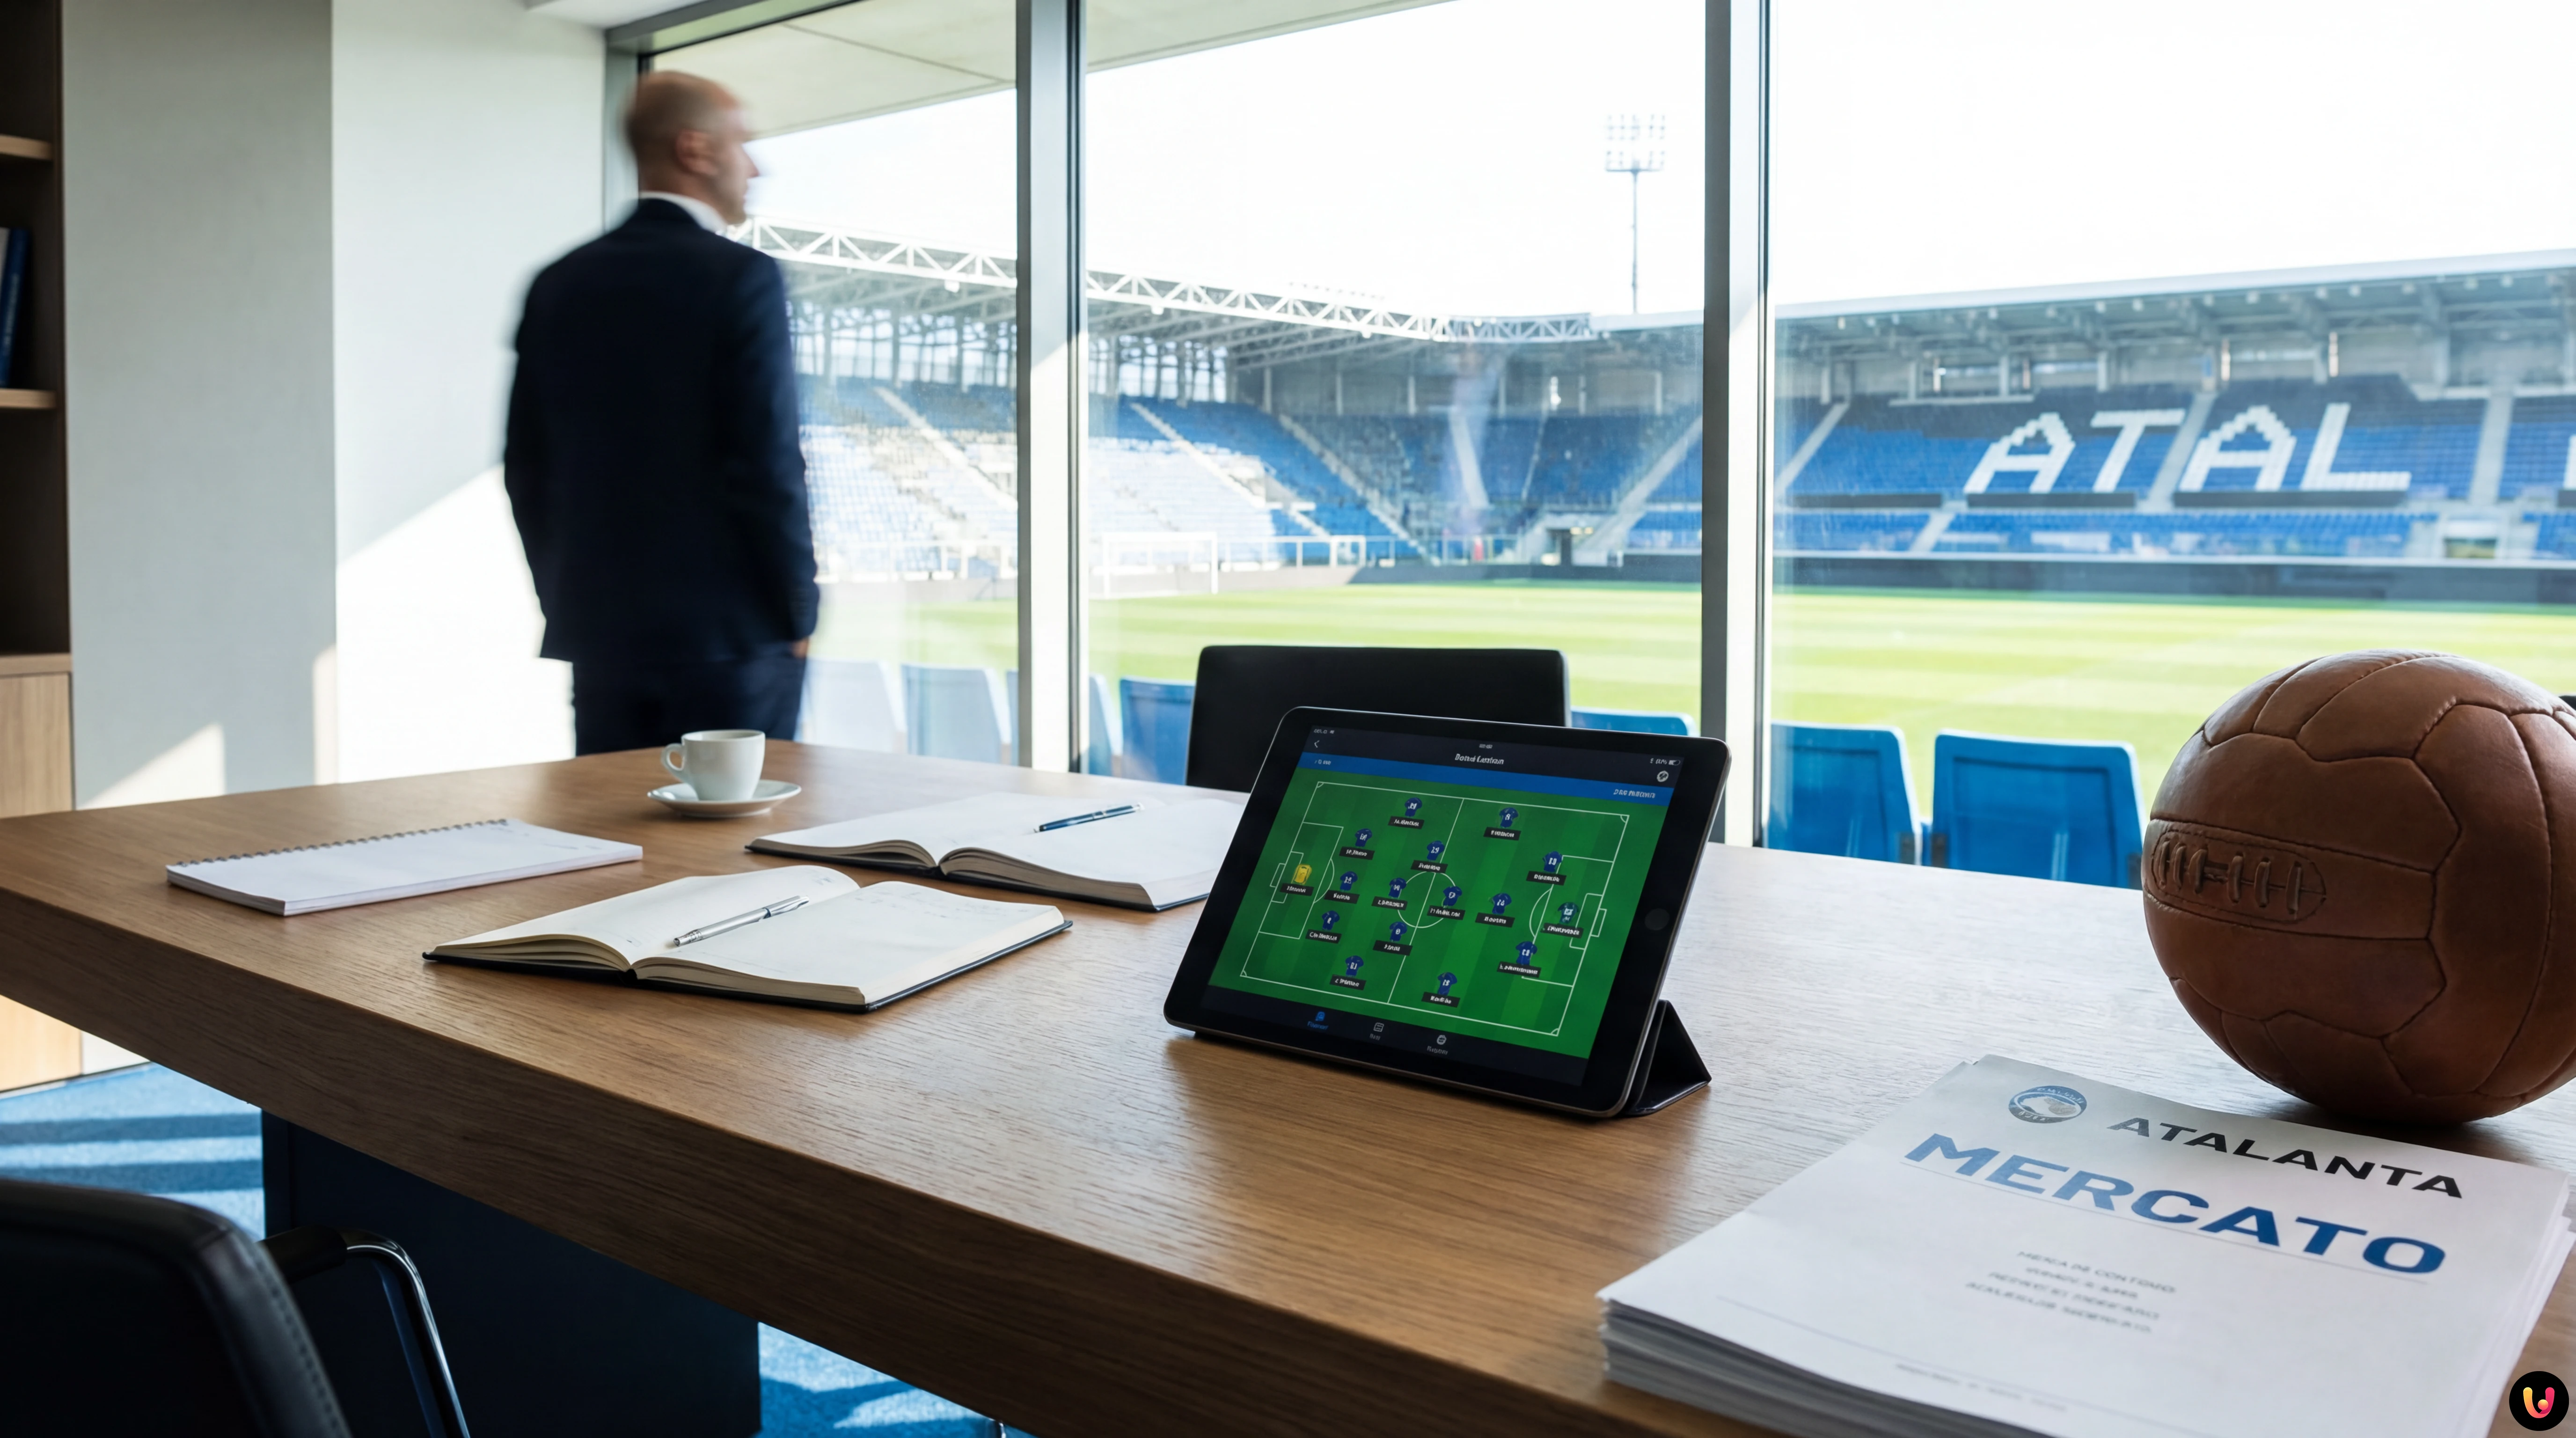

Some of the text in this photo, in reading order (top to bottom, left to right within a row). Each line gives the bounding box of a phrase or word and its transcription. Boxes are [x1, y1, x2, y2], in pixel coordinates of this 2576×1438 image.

[1963, 403, 2576, 493] ATAL
[2106, 1117, 2462, 1199] ATALANTA
[1903, 1133, 2446, 1274] MERCATO
